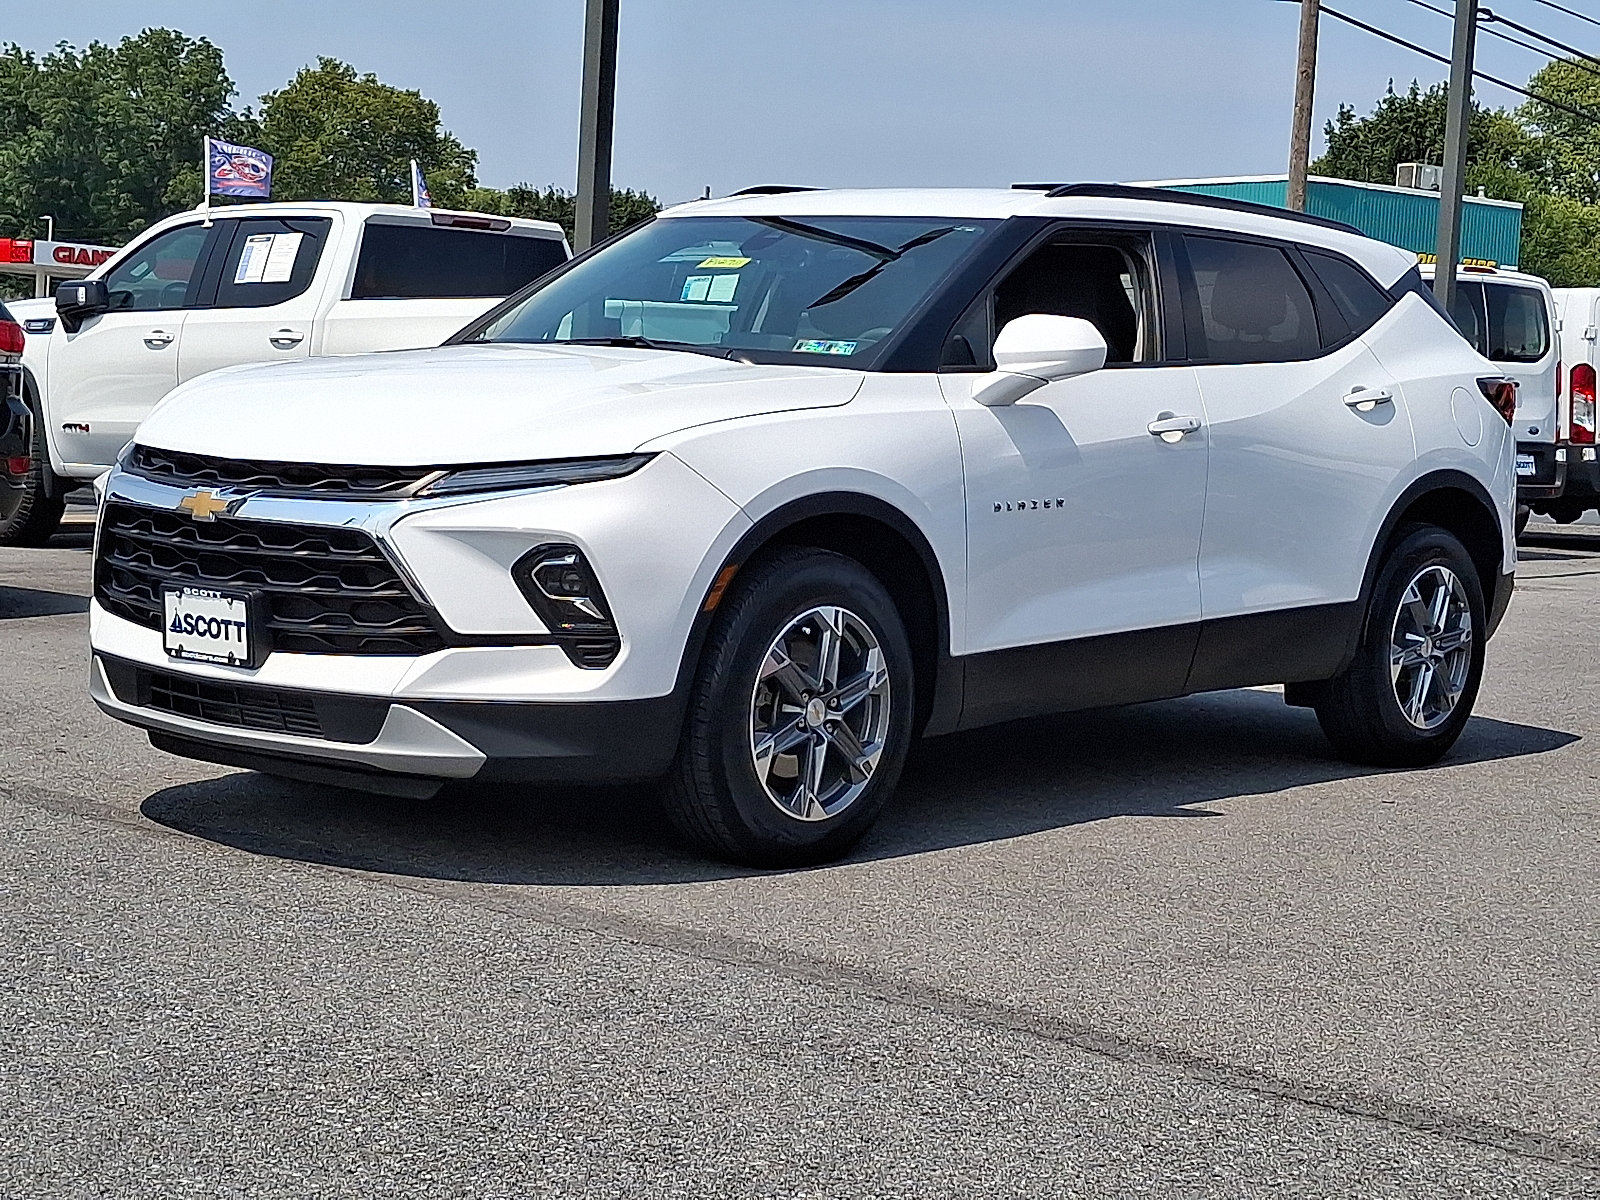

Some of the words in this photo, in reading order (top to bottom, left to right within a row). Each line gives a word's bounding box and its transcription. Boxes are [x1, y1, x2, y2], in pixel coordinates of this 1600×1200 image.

[993, 497, 1065, 513] BLAZER
[183, 586, 222, 599] SCOTT
[183, 612, 246, 643] SCOTT
